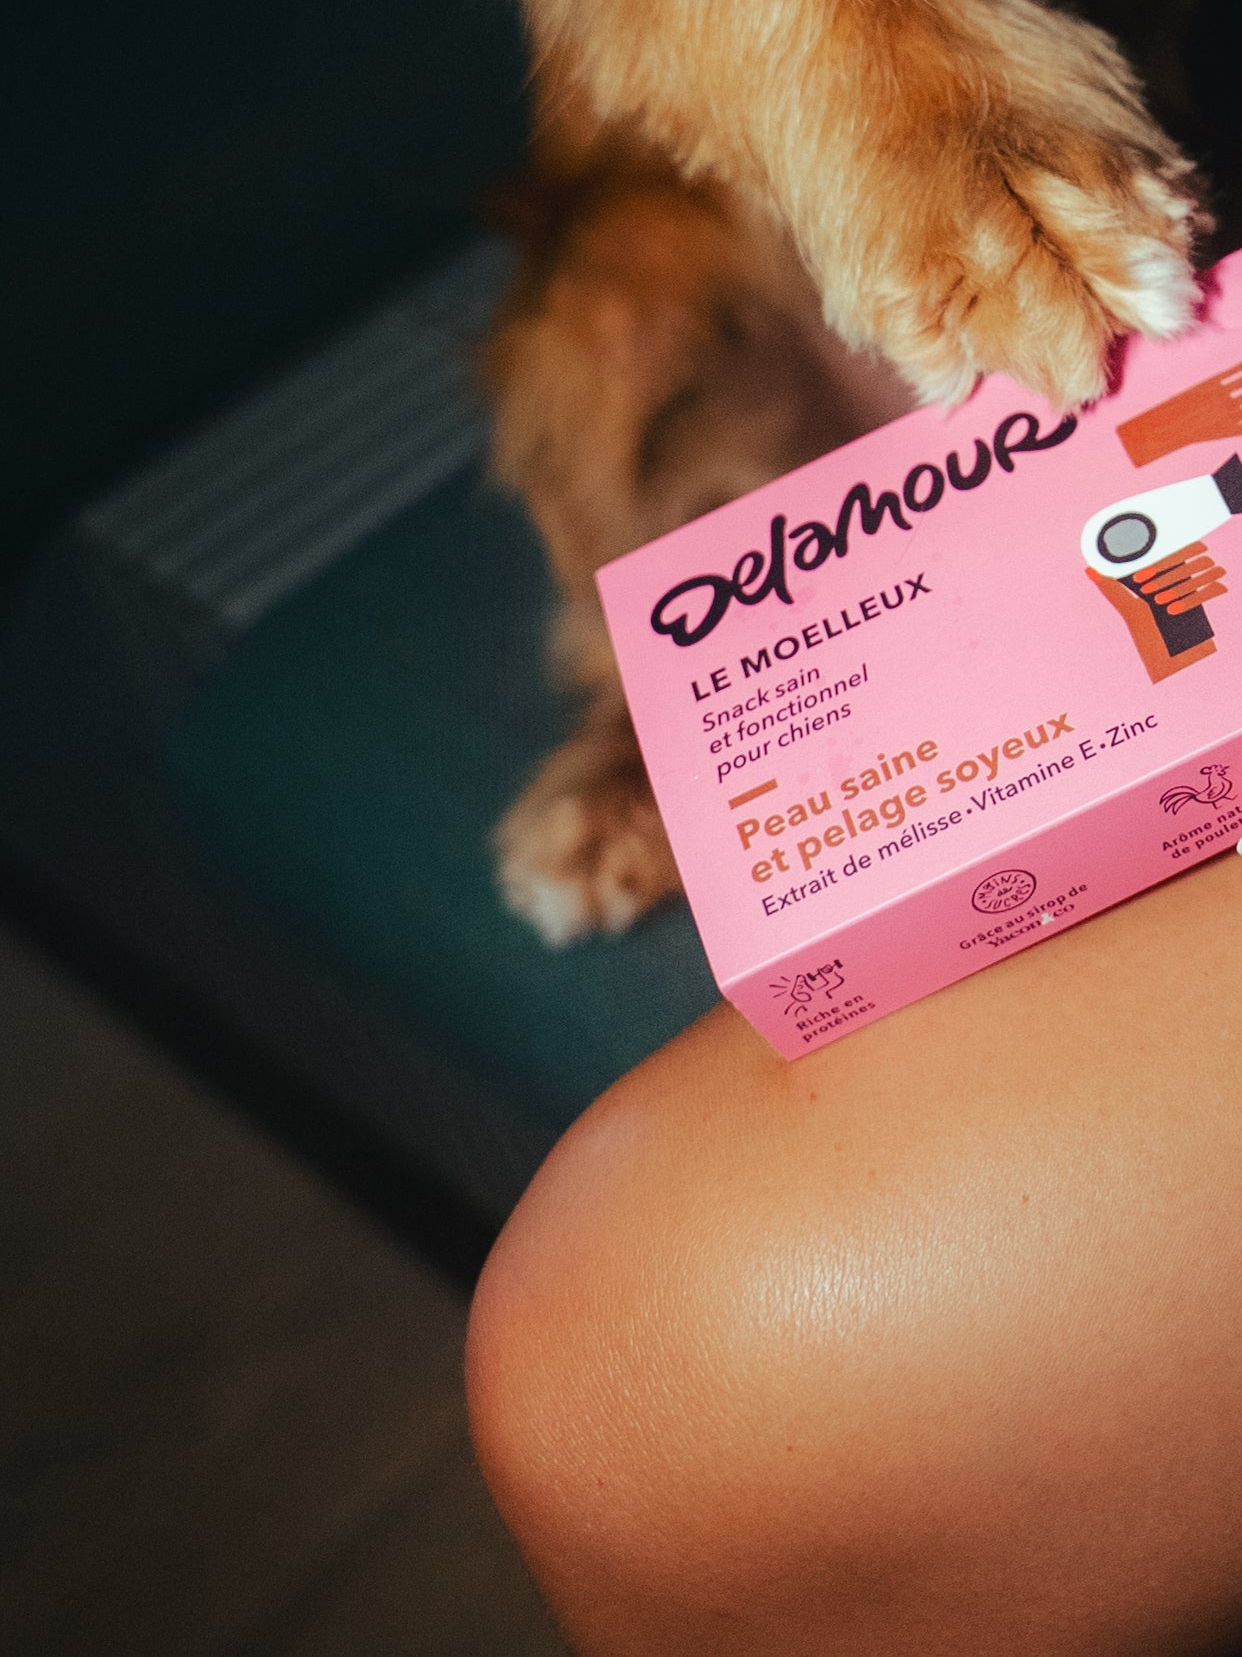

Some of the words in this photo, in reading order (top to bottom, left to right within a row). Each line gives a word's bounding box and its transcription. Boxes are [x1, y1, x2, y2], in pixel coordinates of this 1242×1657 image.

[691, 667, 732, 702] LE
[740, 571, 932, 679] MOELLEUX
[702, 688, 770, 733] Snack
[775, 667, 820, 698] sain
[709, 732, 732, 754] et
[737, 663, 868, 741] fonctionnel
[717, 740, 771, 783] pour
[778, 703, 852, 747] chiens
[736, 791, 831, 851] Peau
[840, 739, 939, 801] saine
[750, 848, 789, 884] et
[797, 784, 928, 871] pelage
[936, 712, 1076, 794] soyeux
[1162, 821, 1213, 851] Arôme
[1171, 845, 1191, 859] de
[761, 867, 838, 917] Extrait
[842, 853, 872, 877] de
[959, 924, 1004, 950] Grâce
[1006, 914, 1025, 929] au
[1026, 894, 1066, 918] sirop
[1068, 883, 1089, 898] de
[796, 1006, 840, 1031] Riche
[844, 994, 864, 1007] en
[802, 1002, 876, 1043] protéines
